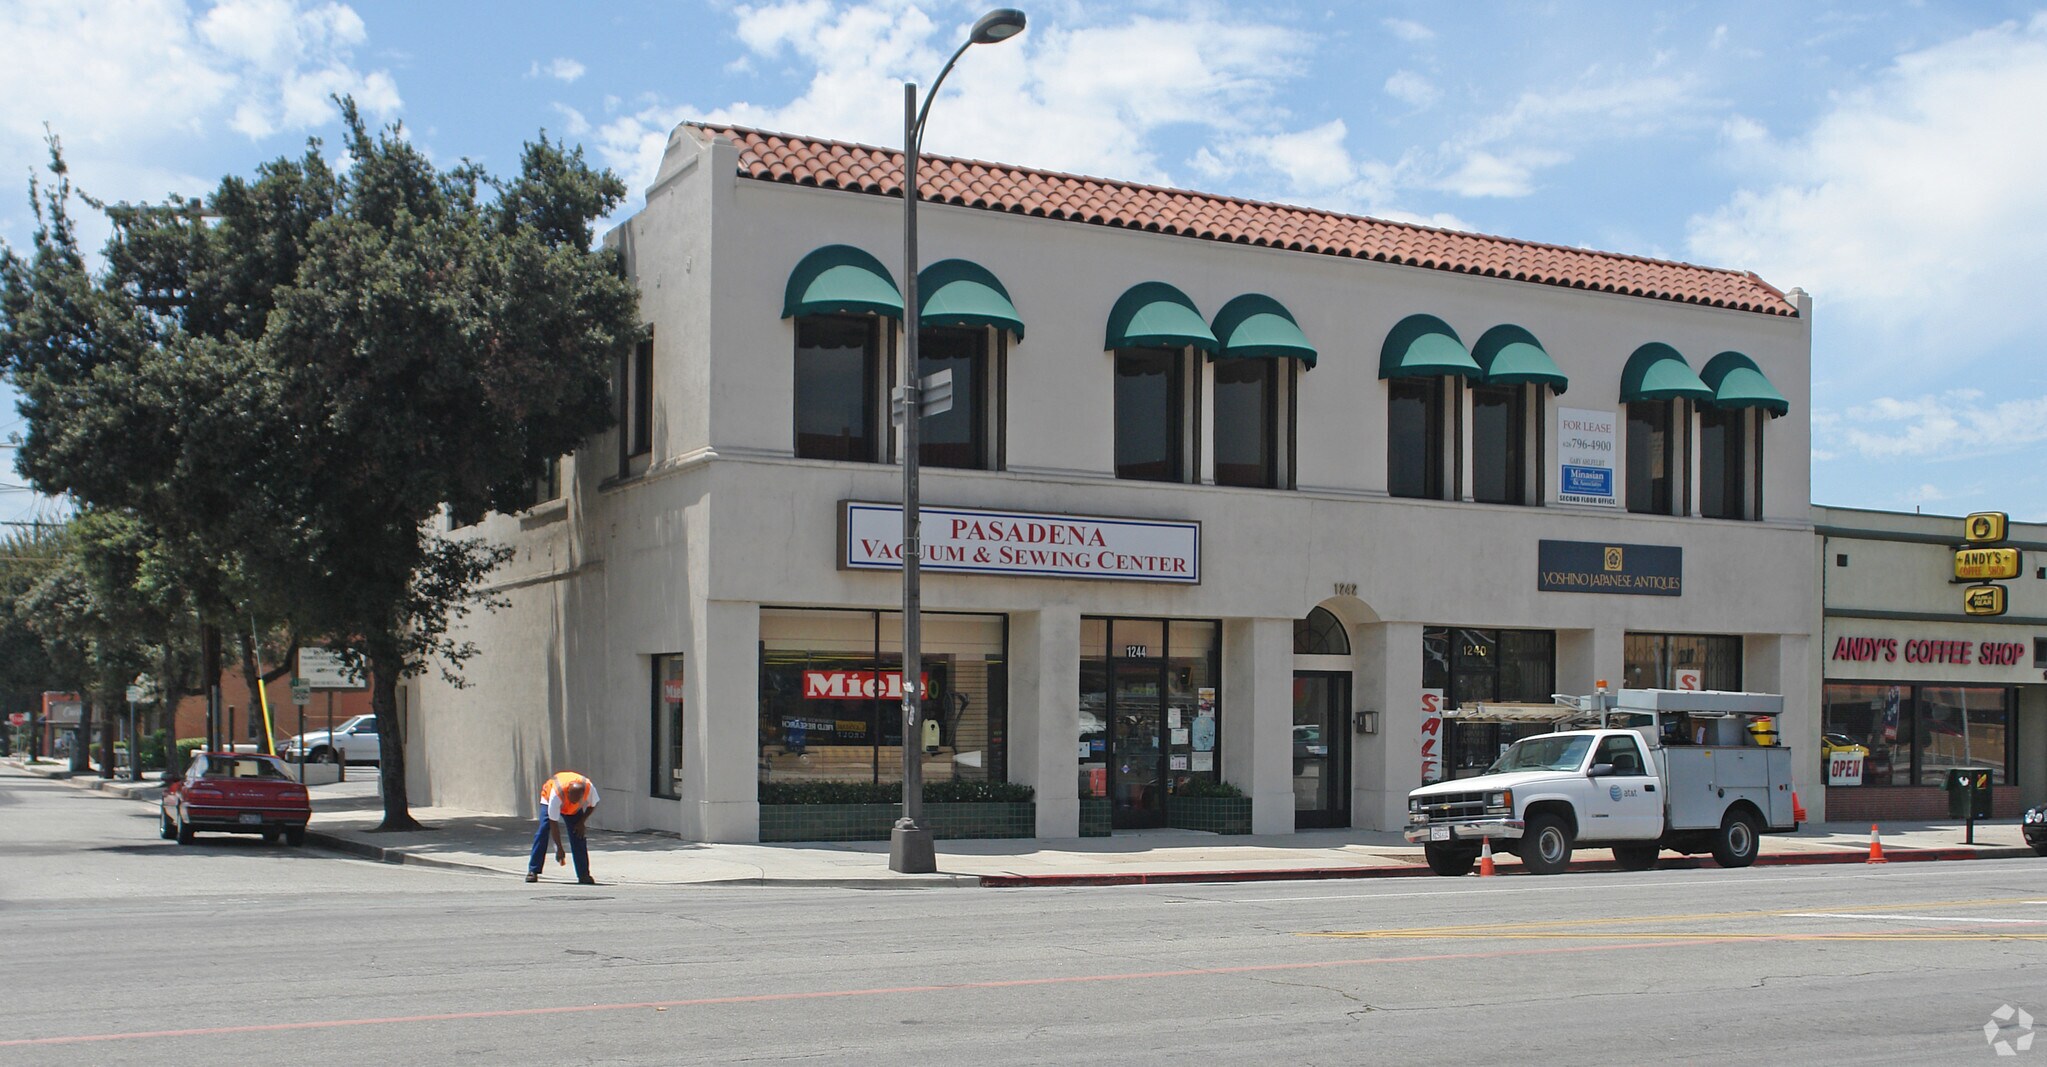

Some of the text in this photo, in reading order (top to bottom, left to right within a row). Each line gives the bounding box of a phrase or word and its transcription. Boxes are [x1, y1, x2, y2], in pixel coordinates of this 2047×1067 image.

[1563, 419, 1612, 434] FOR LEASE
[1570, 469, 1604, 480] Minasian
[1559, 495, 1616, 505] SECOND FLOOR OFFICE
[950, 518, 1107, 547] PASADENA
[972, 546, 991, 563] &
[999, 545, 1091, 568] SEWING
[1097, 551, 1187, 573] CENTER
[1964, 551, 2002, 565] ANDY'S
[1960, 565, 2006, 576] COFFEE SHOP
[1543, 571, 1680, 590] YOSHINO JAPANESE ANTIQUES
[1126, 645, 1147, 658] 1244
[1463, 645, 1487, 656] 1240
[1832, 636, 2026, 665] ANDY'S COFFEE SHOP
[806, 673, 926, 698] Miel
[1420, 693, 1442, 782] SALE
[1831, 760, 1861, 778] OPEN
